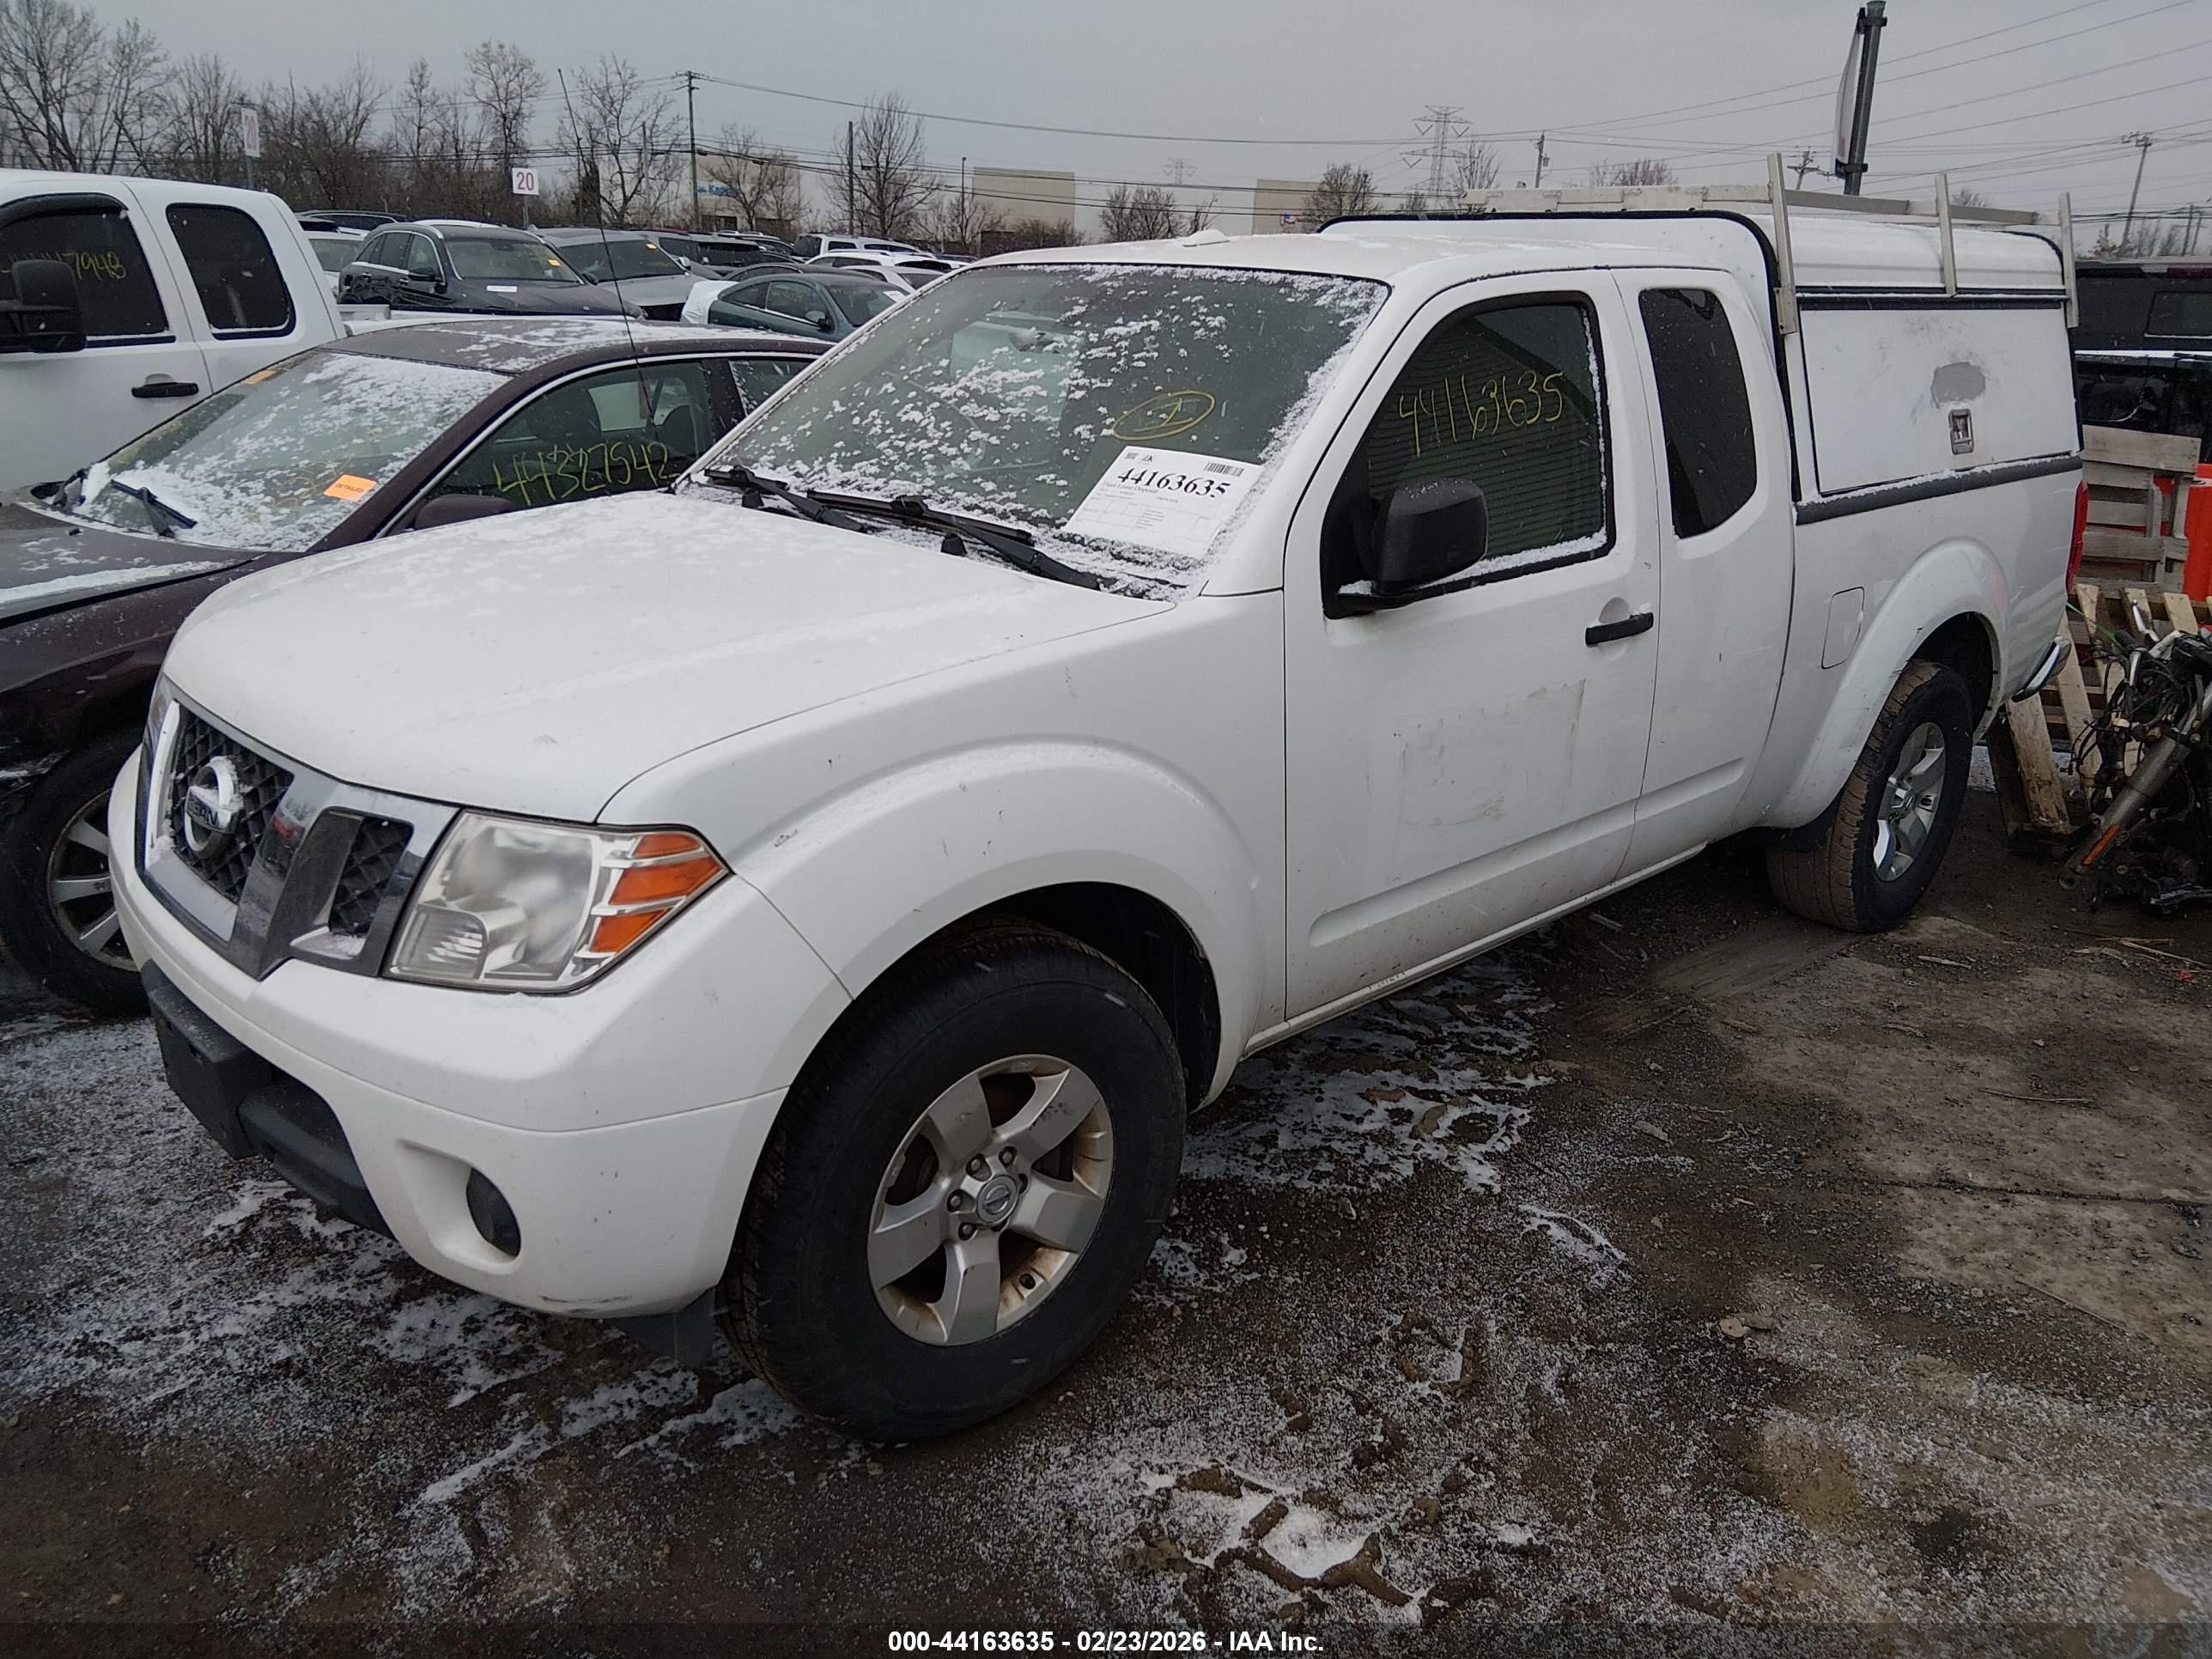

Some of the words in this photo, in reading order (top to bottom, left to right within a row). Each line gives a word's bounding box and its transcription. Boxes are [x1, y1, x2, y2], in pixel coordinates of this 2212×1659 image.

[516, 172, 534, 191] 20
[1399, 369, 1564, 458] 44163635
[1117, 467, 1231, 498] 44163635
